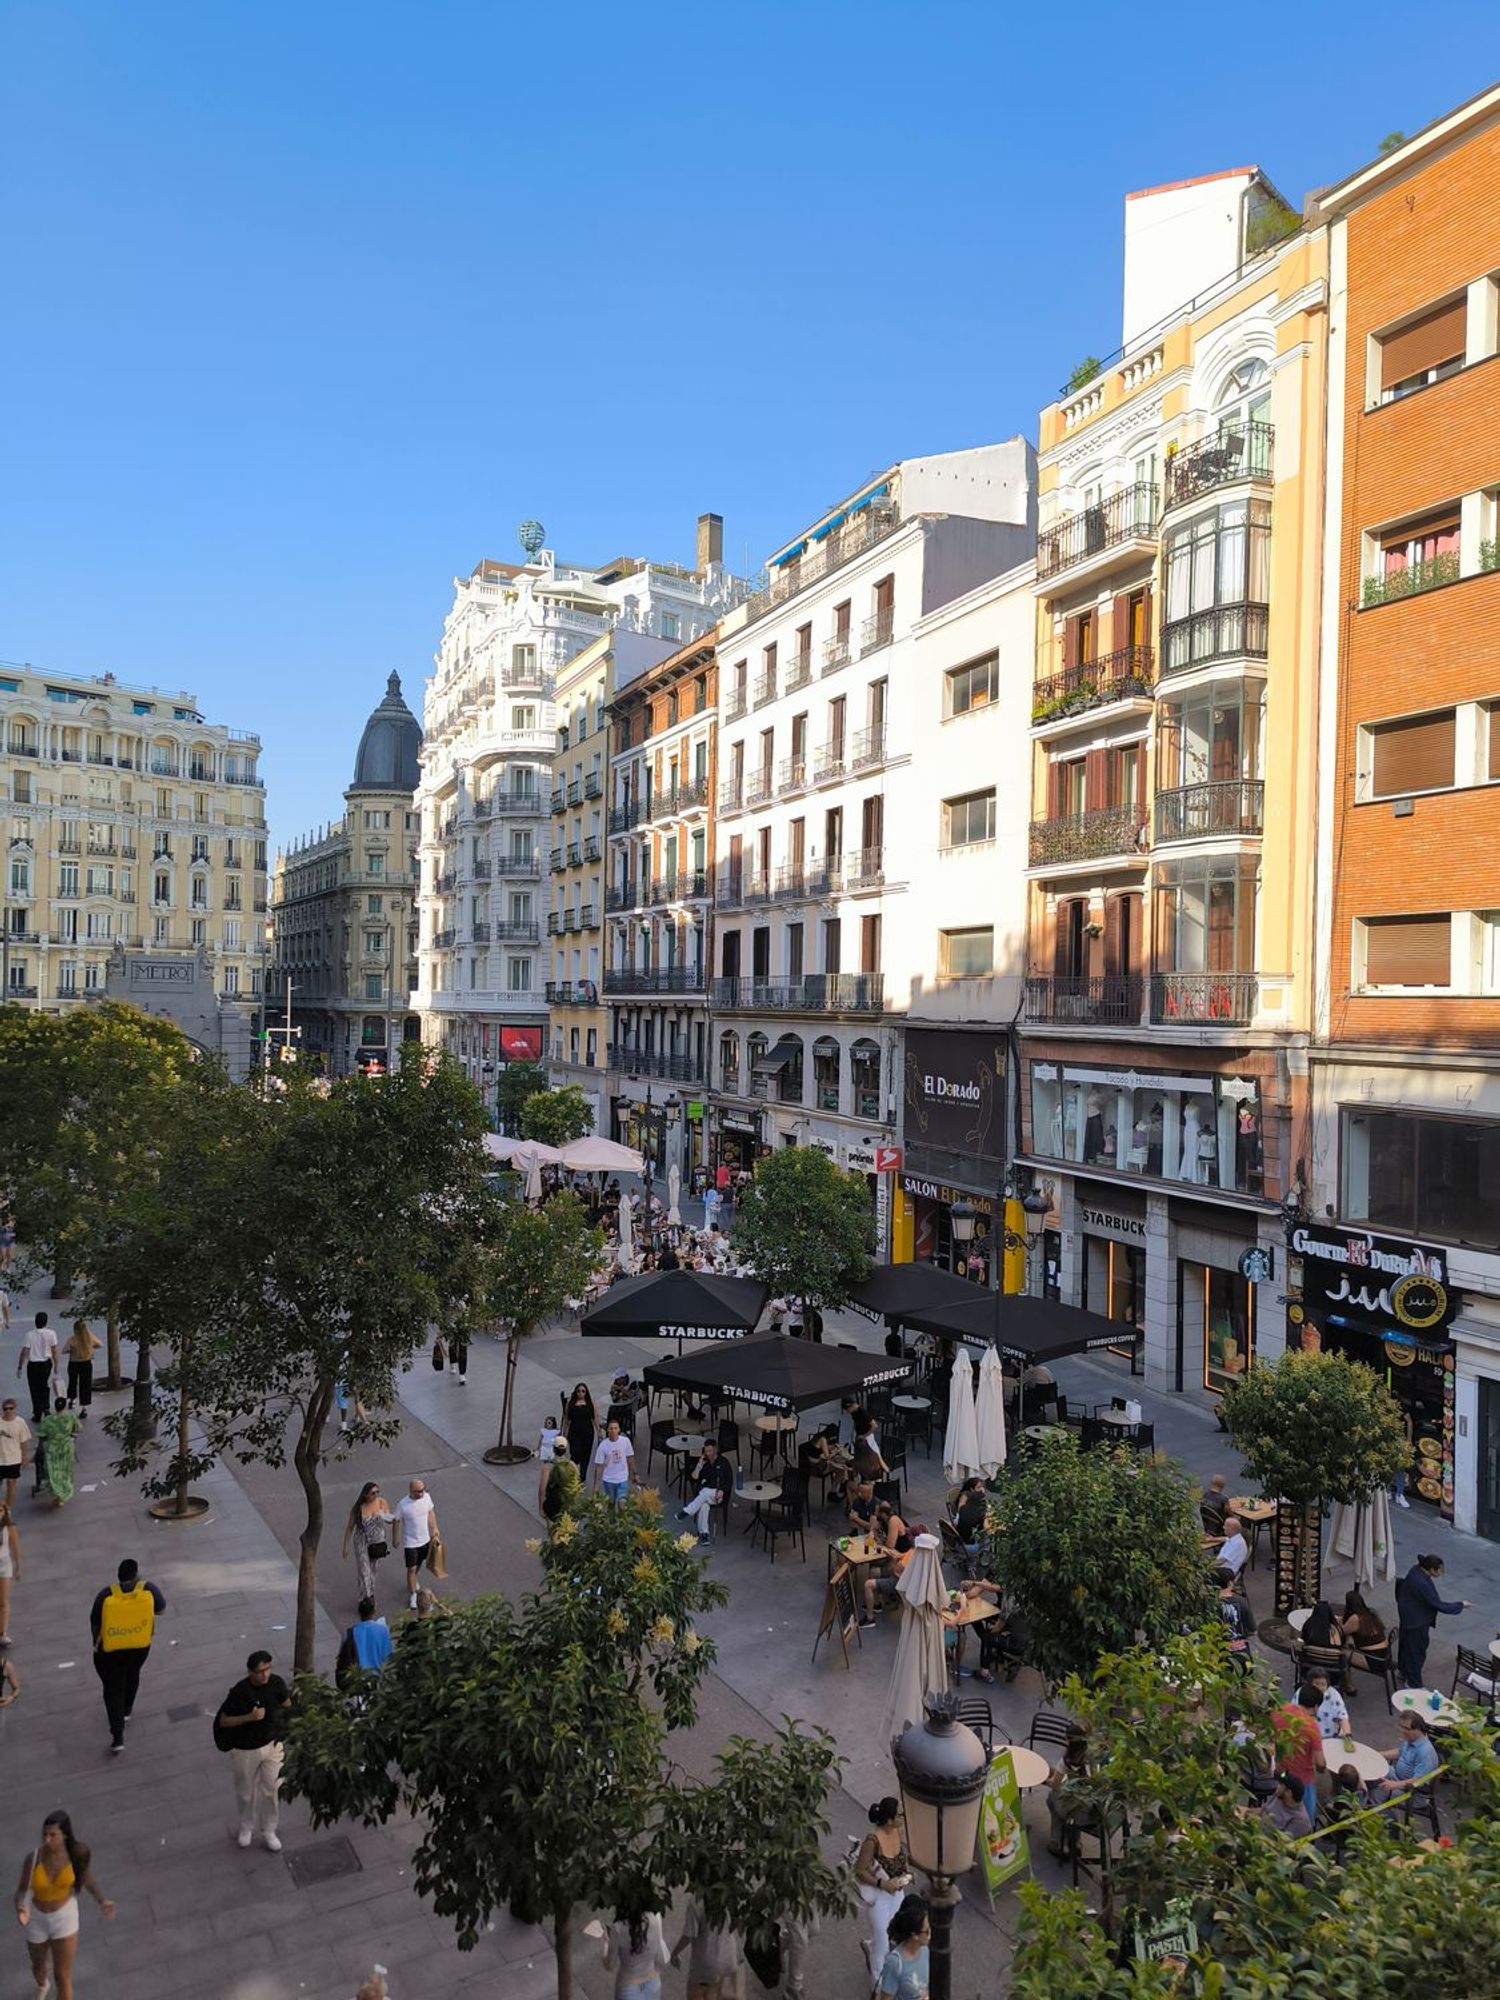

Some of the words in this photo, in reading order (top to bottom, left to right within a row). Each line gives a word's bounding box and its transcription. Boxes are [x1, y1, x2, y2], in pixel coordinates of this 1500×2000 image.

[136, 965, 188, 980] METRO
[904, 1177, 938, 1199] SALÓN
[1082, 1209, 1146, 1237] STARBUCK
[659, 1325, 744, 1339] STARBUCKS
[962, 1333, 989, 1347] STARBU
[1086, 1336, 1117, 1348] STARBUCKS
[863, 1365, 910, 1387] STARBUCKS
[722, 1385, 788, 1408] STARBUCKS
[107, 1624, 144, 1637] Glovo
[1148, 1934, 1187, 1961] PASTA
